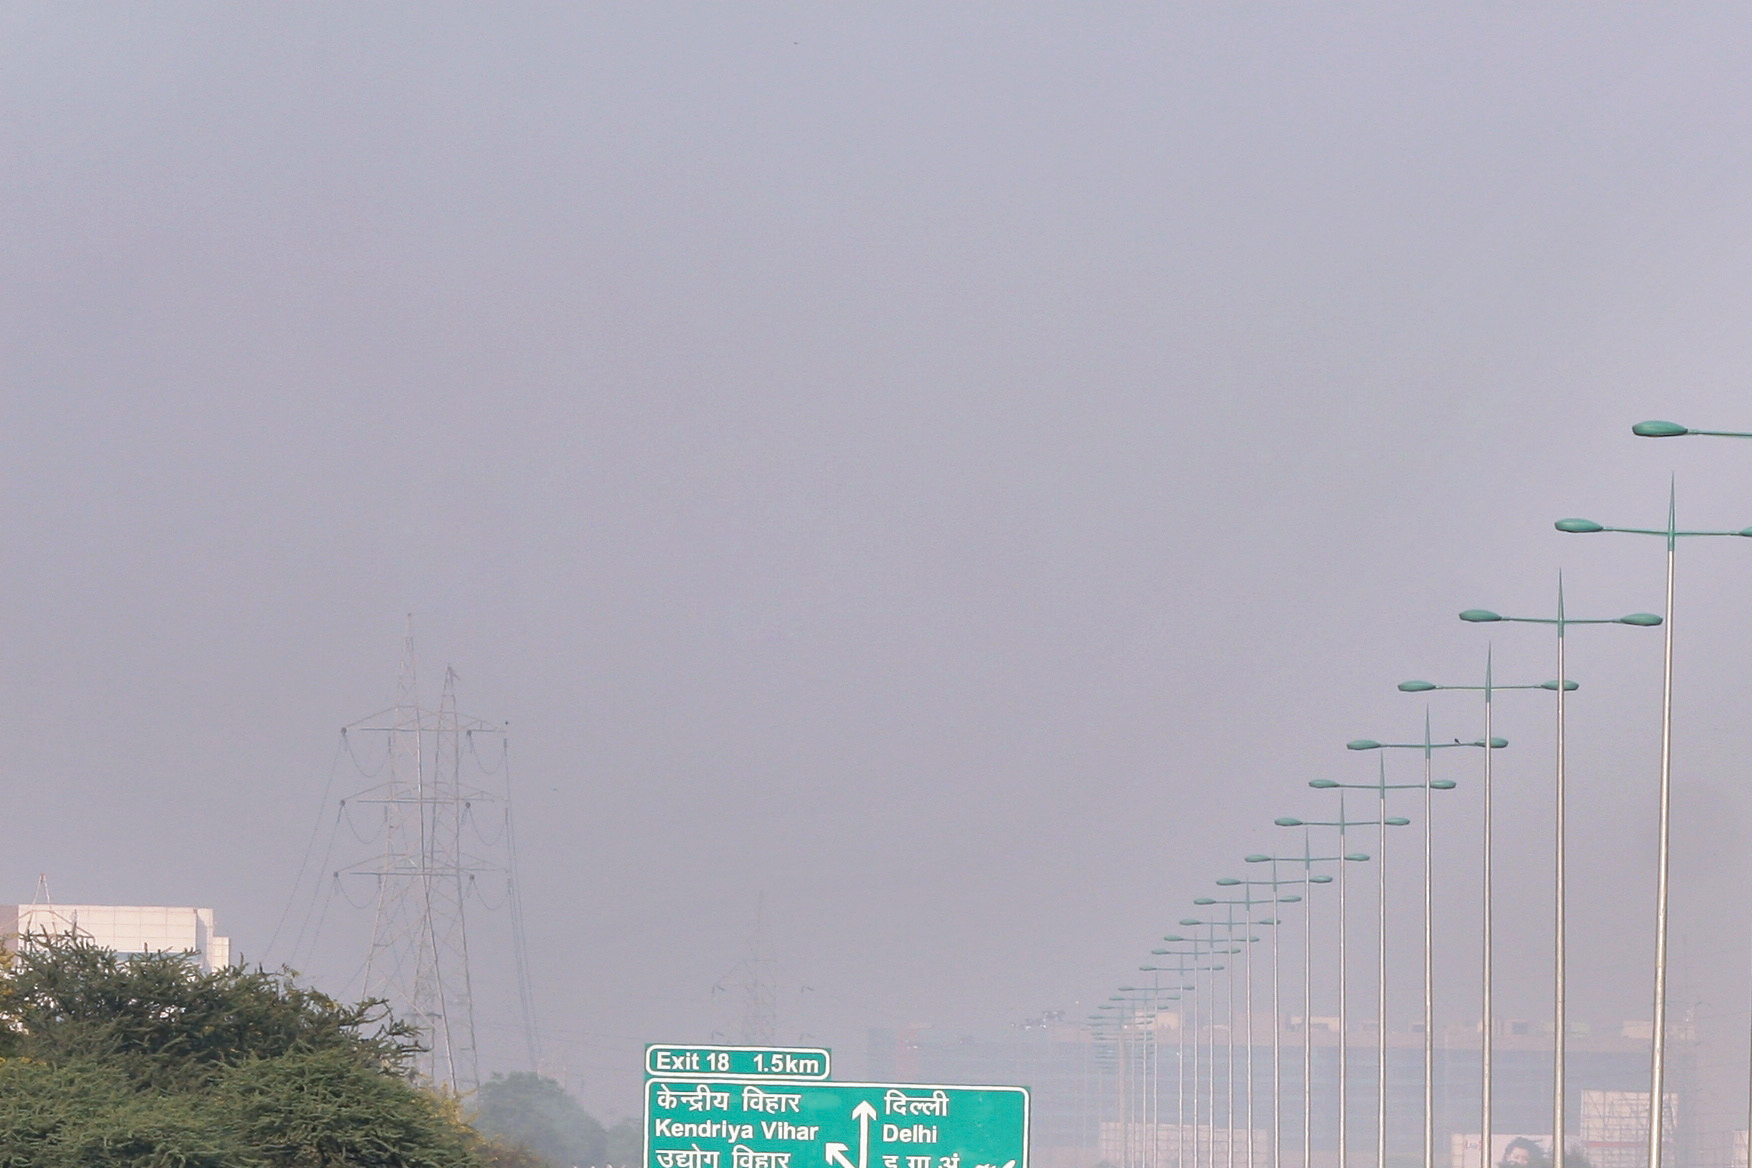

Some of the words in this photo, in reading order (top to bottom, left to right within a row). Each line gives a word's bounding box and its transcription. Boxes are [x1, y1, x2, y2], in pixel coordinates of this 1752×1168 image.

[656, 1051, 700, 1071] Exit
[706, 1052, 730, 1072] 18
[656, 1084, 731, 1112] केन्द्रीय
[742, 1086, 802, 1115] विहार
[883, 1089, 950, 1117] दिल्ली
[655, 1118, 754, 1144] Kendriya
[761, 1121, 820, 1141] Vihar
[882, 1124, 938, 1144] Delhi
